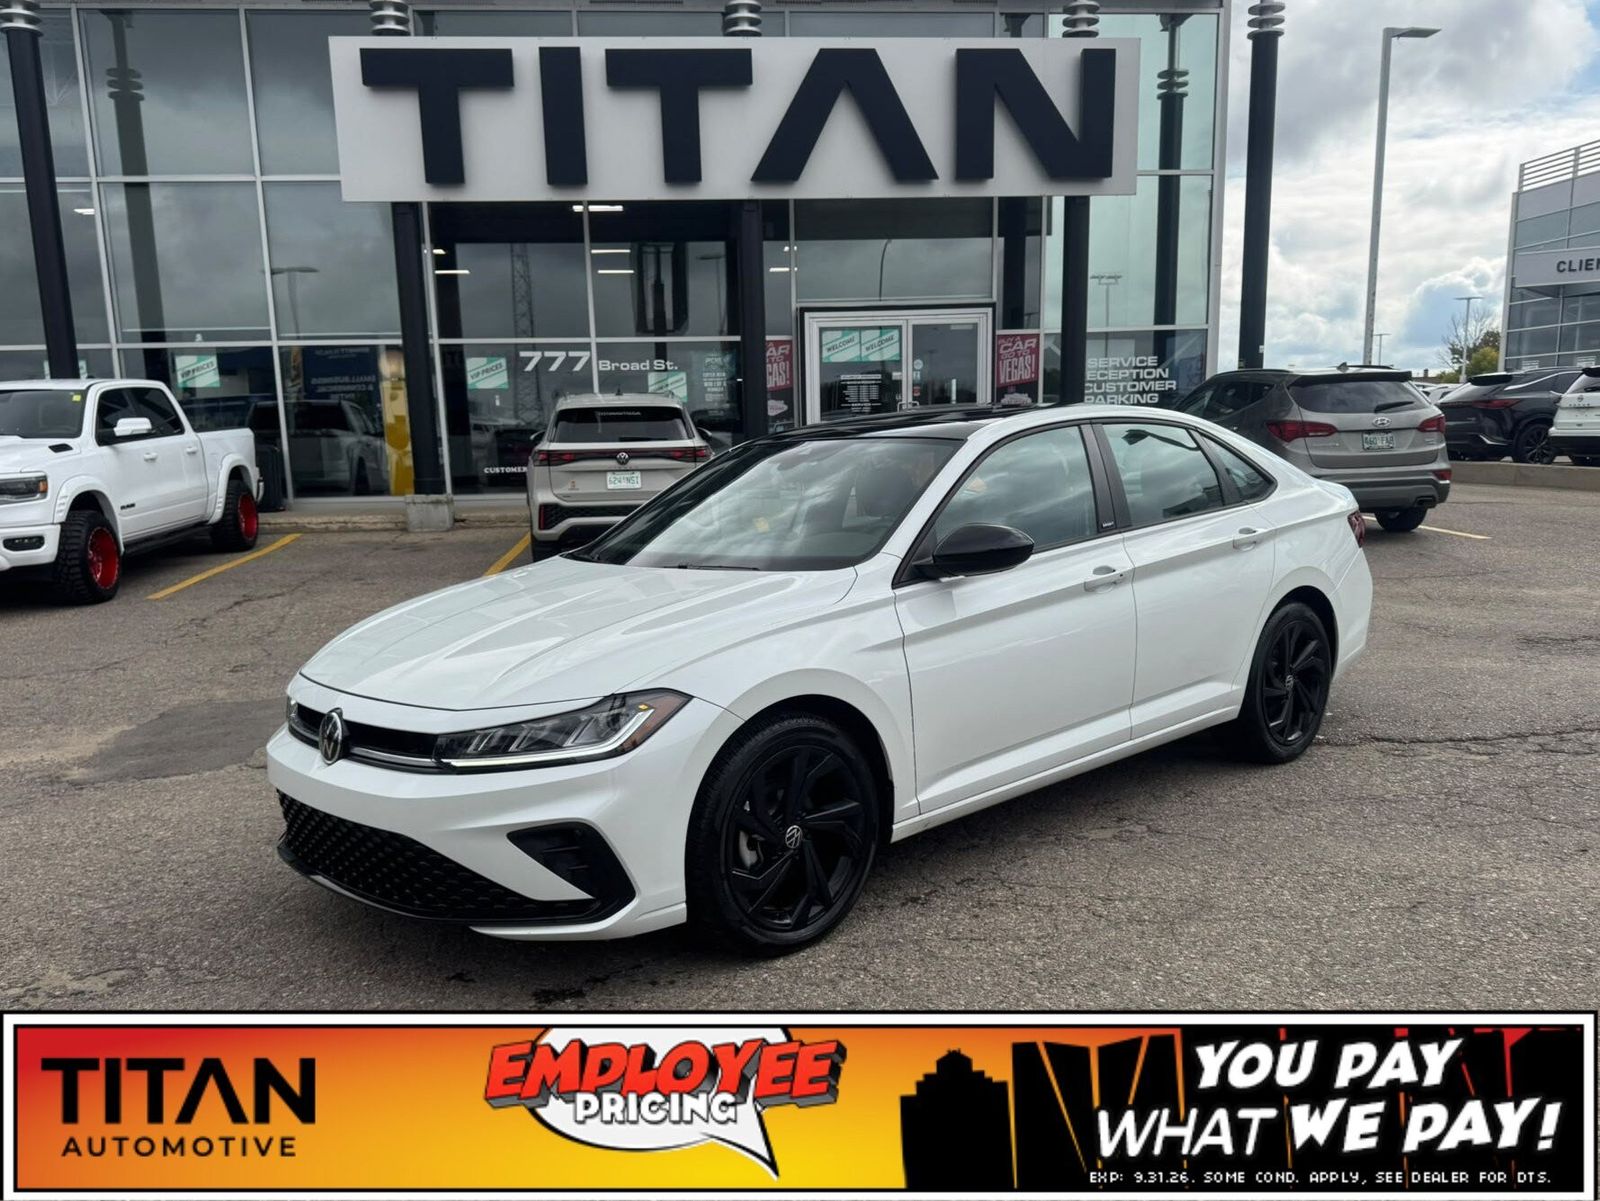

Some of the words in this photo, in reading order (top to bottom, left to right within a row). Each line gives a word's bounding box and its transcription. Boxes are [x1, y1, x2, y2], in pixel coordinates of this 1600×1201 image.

[360, 46, 1116, 185] TITAN
[766, 345, 790, 357] AR
[826, 336, 855, 352] WELCOME
[865, 335, 895, 351] WELCOME
[1000, 338, 1037, 354] CAR
[519, 351, 590, 372] 777
[599, 360, 650, 371] Broad
[653, 360, 678, 371] St.
[1000, 354, 1036, 384] VEGAS!
[1087, 356, 1158, 368] SERVICE
[766, 361, 790, 388] GAS!
[1086, 368, 1169, 380] ECEPTION
[1085, 380, 1177, 393] CUSTOMER
[1085, 393, 1159, 405] PARKING
